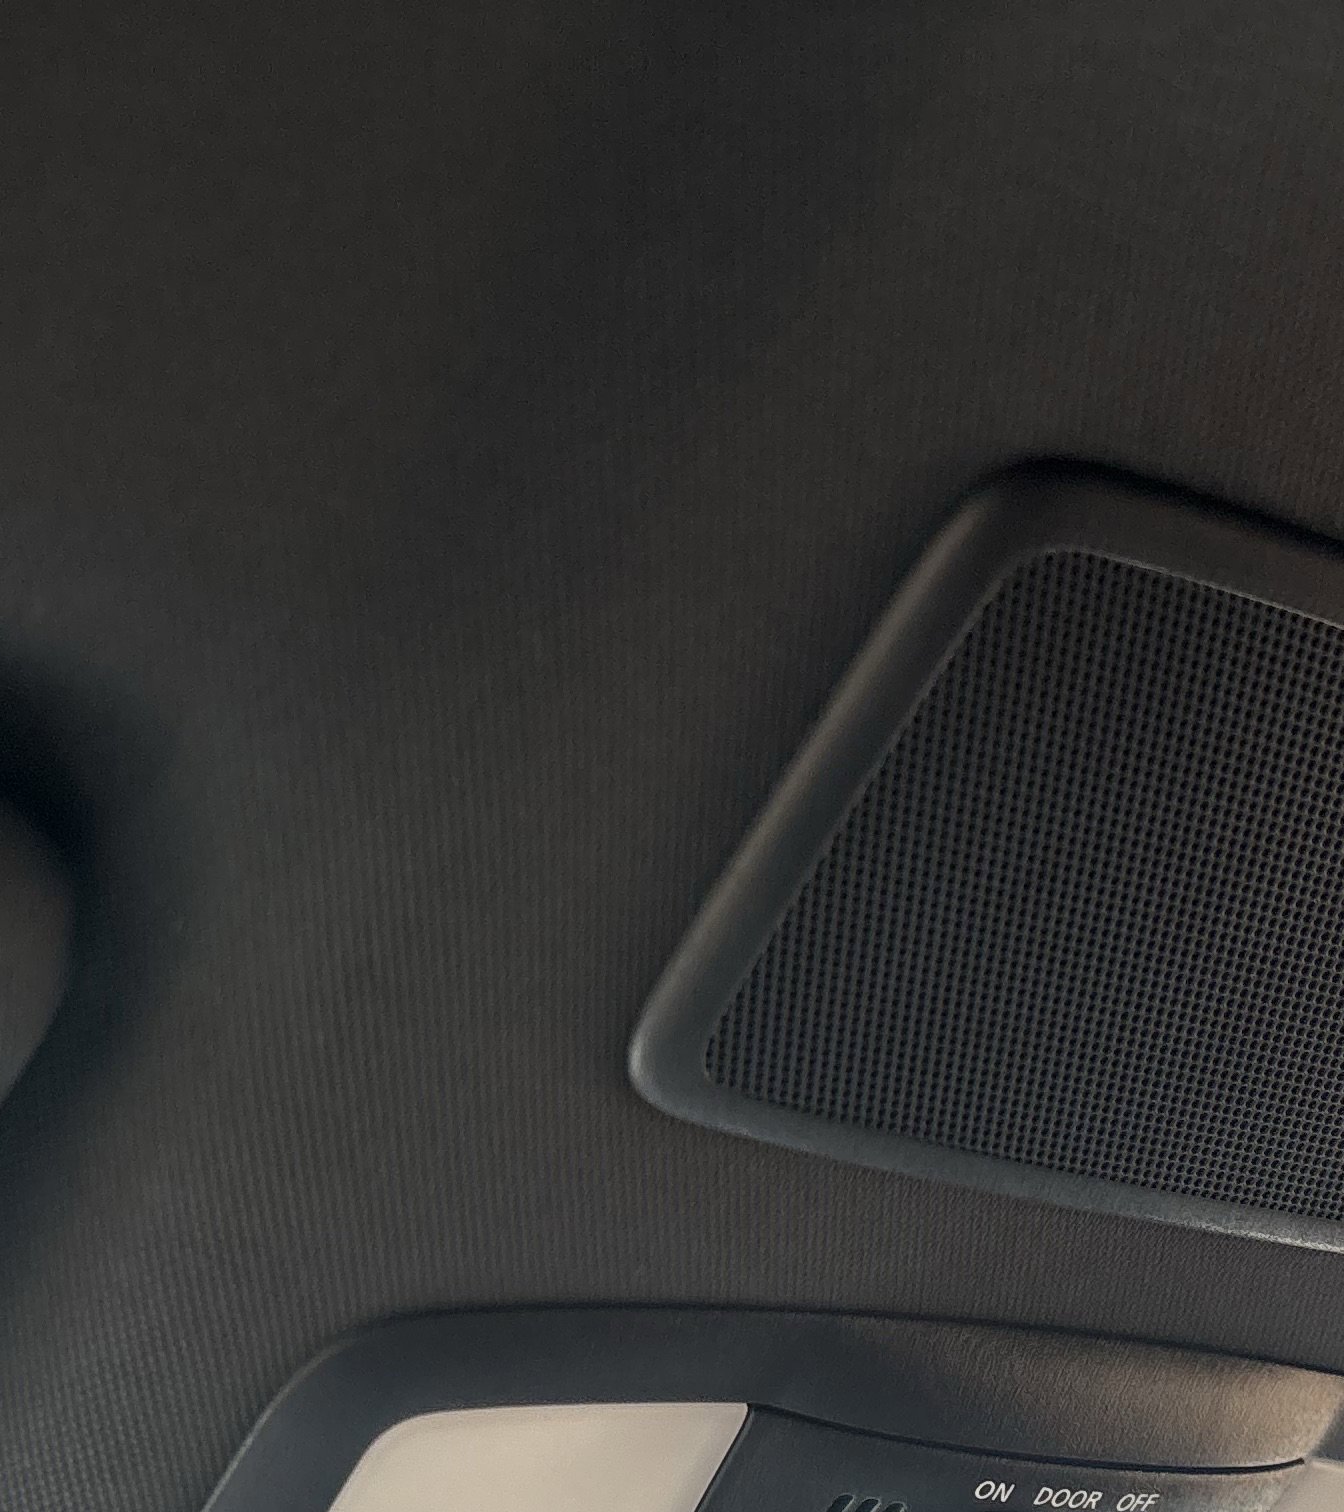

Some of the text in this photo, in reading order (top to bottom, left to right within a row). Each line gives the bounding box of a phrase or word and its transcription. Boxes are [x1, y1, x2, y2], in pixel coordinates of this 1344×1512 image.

[974, 1480, 1015, 1503] ON
[1033, 1486, 1103, 1510] DOOR
[1116, 1493, 1160, 1512] OFF
